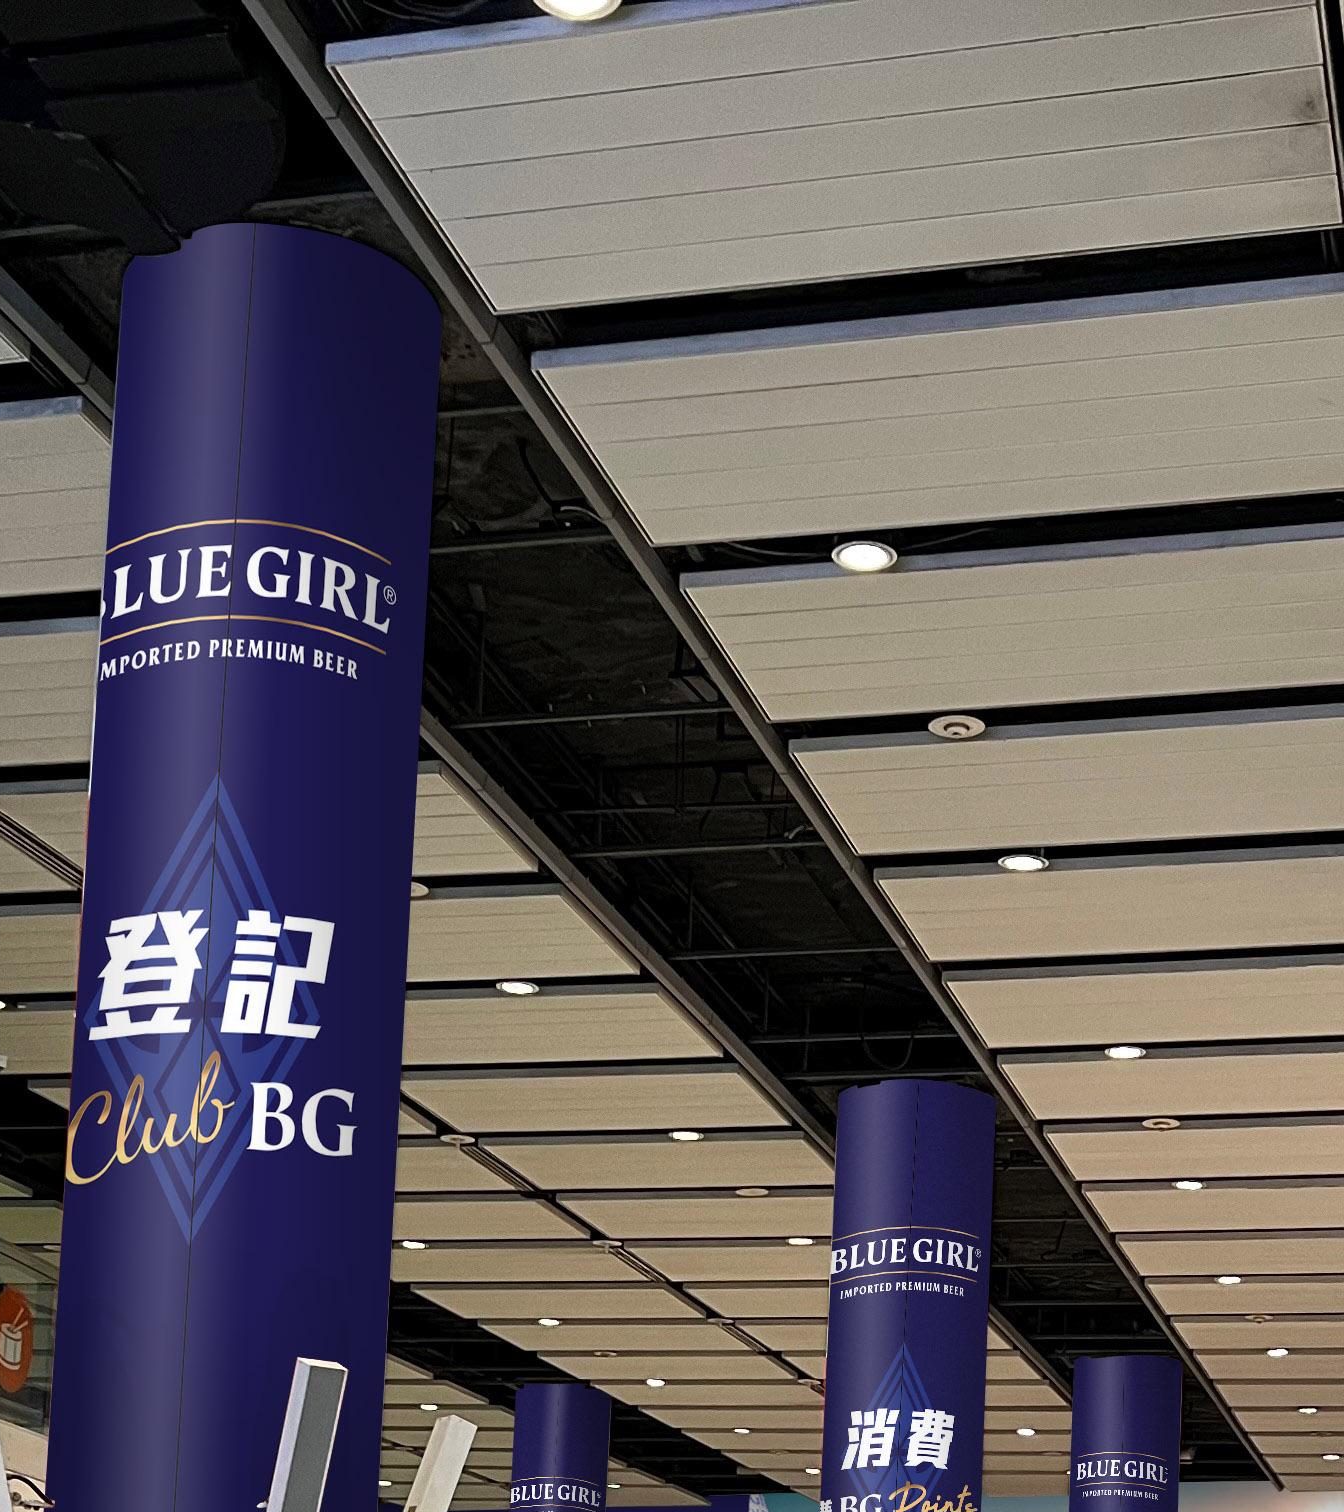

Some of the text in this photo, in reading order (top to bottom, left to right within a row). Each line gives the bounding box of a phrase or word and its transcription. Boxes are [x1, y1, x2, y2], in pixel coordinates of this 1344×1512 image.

[101, 543, 233, 620] LUE
[100, 637, 358, 682] MPORTED PREMIUM BEER
[88, 909, 336, 1041] 登記
[64, 1050, 357, 1185] Club BG
[830, 1238, 906, 1275] BLUE
[840, 1281, 965, 1300] IMPORTED PREMIUM BEER
[841, 1408, 955, 1470] 消費
[1076, 1460, 1121, 1481] BLUE
[510, 1483, 554, 1504] BLUE
[1144, 1491, 1159, 1501] BEER
